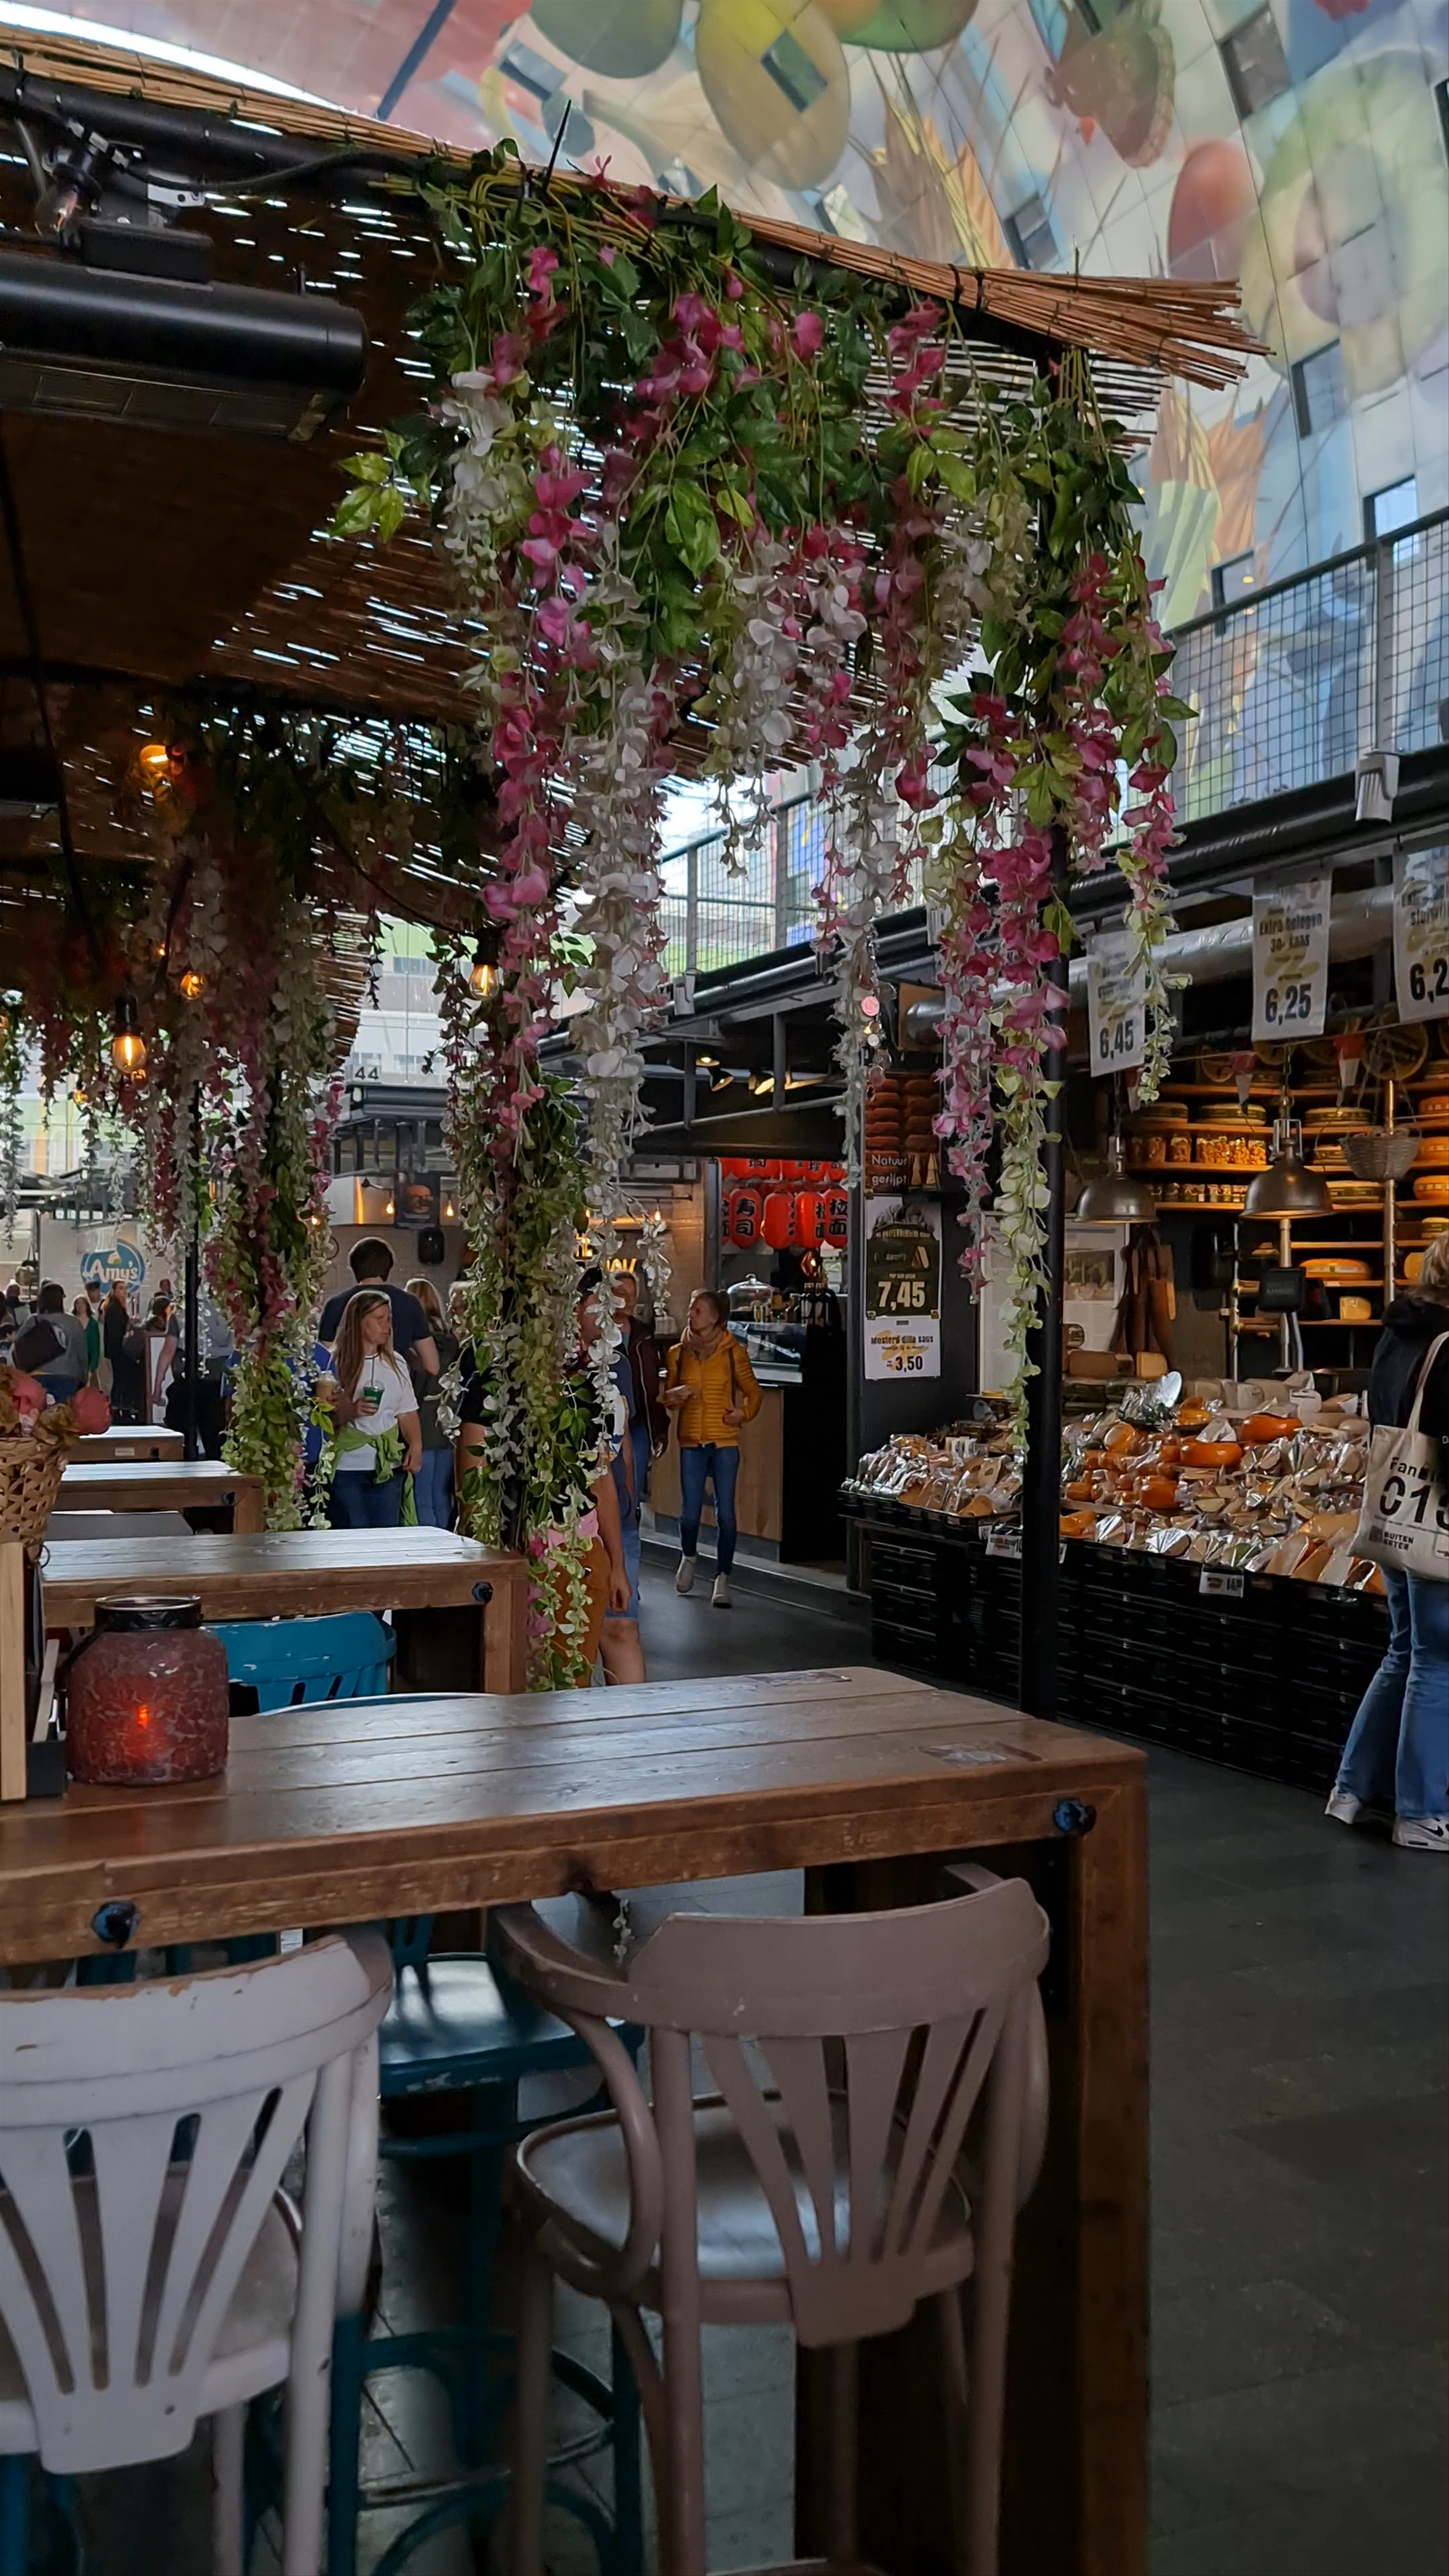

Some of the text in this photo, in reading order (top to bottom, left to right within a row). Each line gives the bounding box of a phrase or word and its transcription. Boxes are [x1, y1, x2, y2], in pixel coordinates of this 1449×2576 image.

[1265, 983, 1311, 1026] 6,25
[1100, 1019, 1134, 1060] 6,45
[355, 1066, 379, 1080] 44
[872, 1154, 907, 1166] Natuur
[872, 1173, 906, 1187] gerijpt
[83, 1259, 138, 1283] Amy's
[878, 1281, 925, 1311] 7,45
[871, 1335, 900, 1344] Mosterd
[895, 1356, 923, 1373] 3,50
[1384, 1531, 1414, 1544] BUITEN
